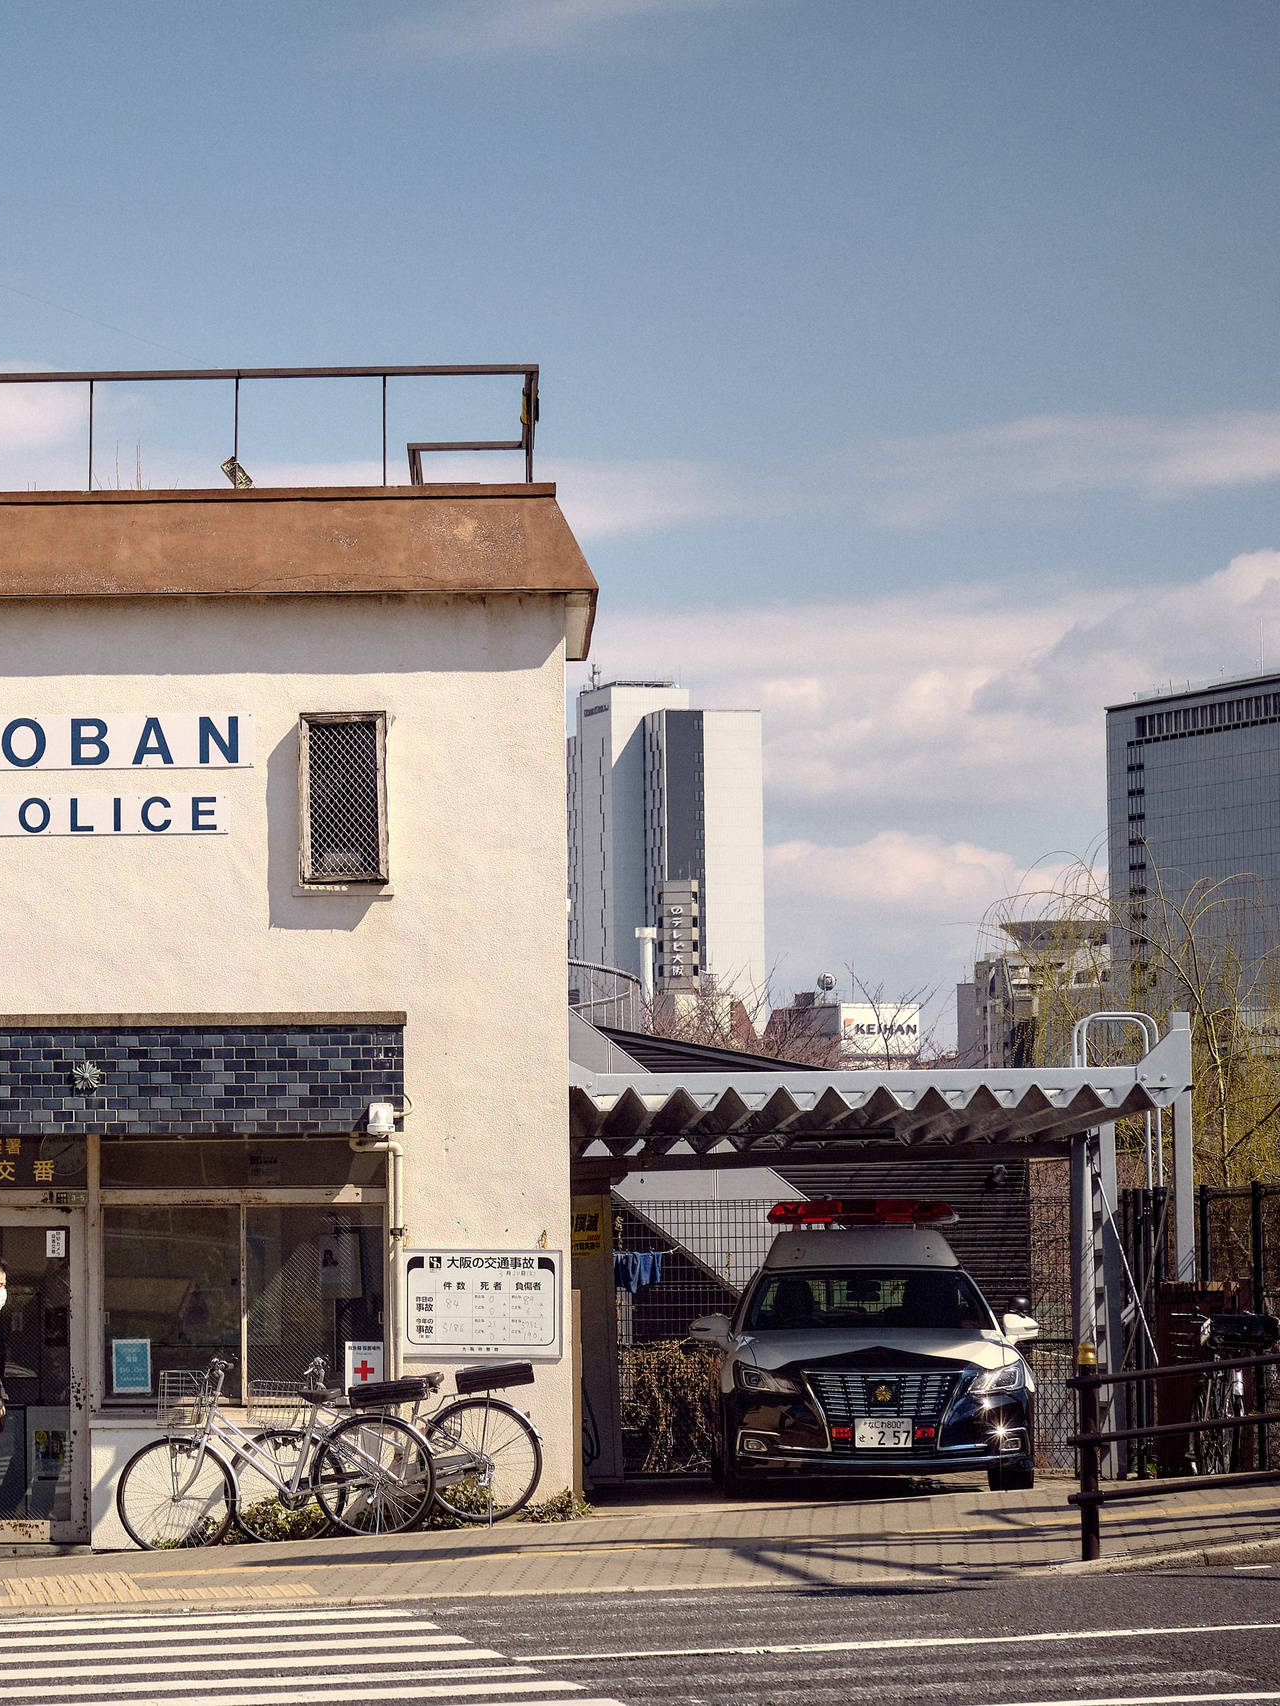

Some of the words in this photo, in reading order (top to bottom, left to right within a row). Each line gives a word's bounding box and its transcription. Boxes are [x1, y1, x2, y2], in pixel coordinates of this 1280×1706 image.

[854, 1023, 918, 1036] KEIHAN
[446, 1256, 535, 1270] 大阪の交通事故
[442, 1281, 466, 1291] 件数
[480, 1281, 502, 1291] 死者
[515, 1281, 542, 1291] 負傷者
[415, 1303, 434, 1312] 事故
[415, 1325, 434, 1334] 事故
[858, 1434, 866, 1442] せ
